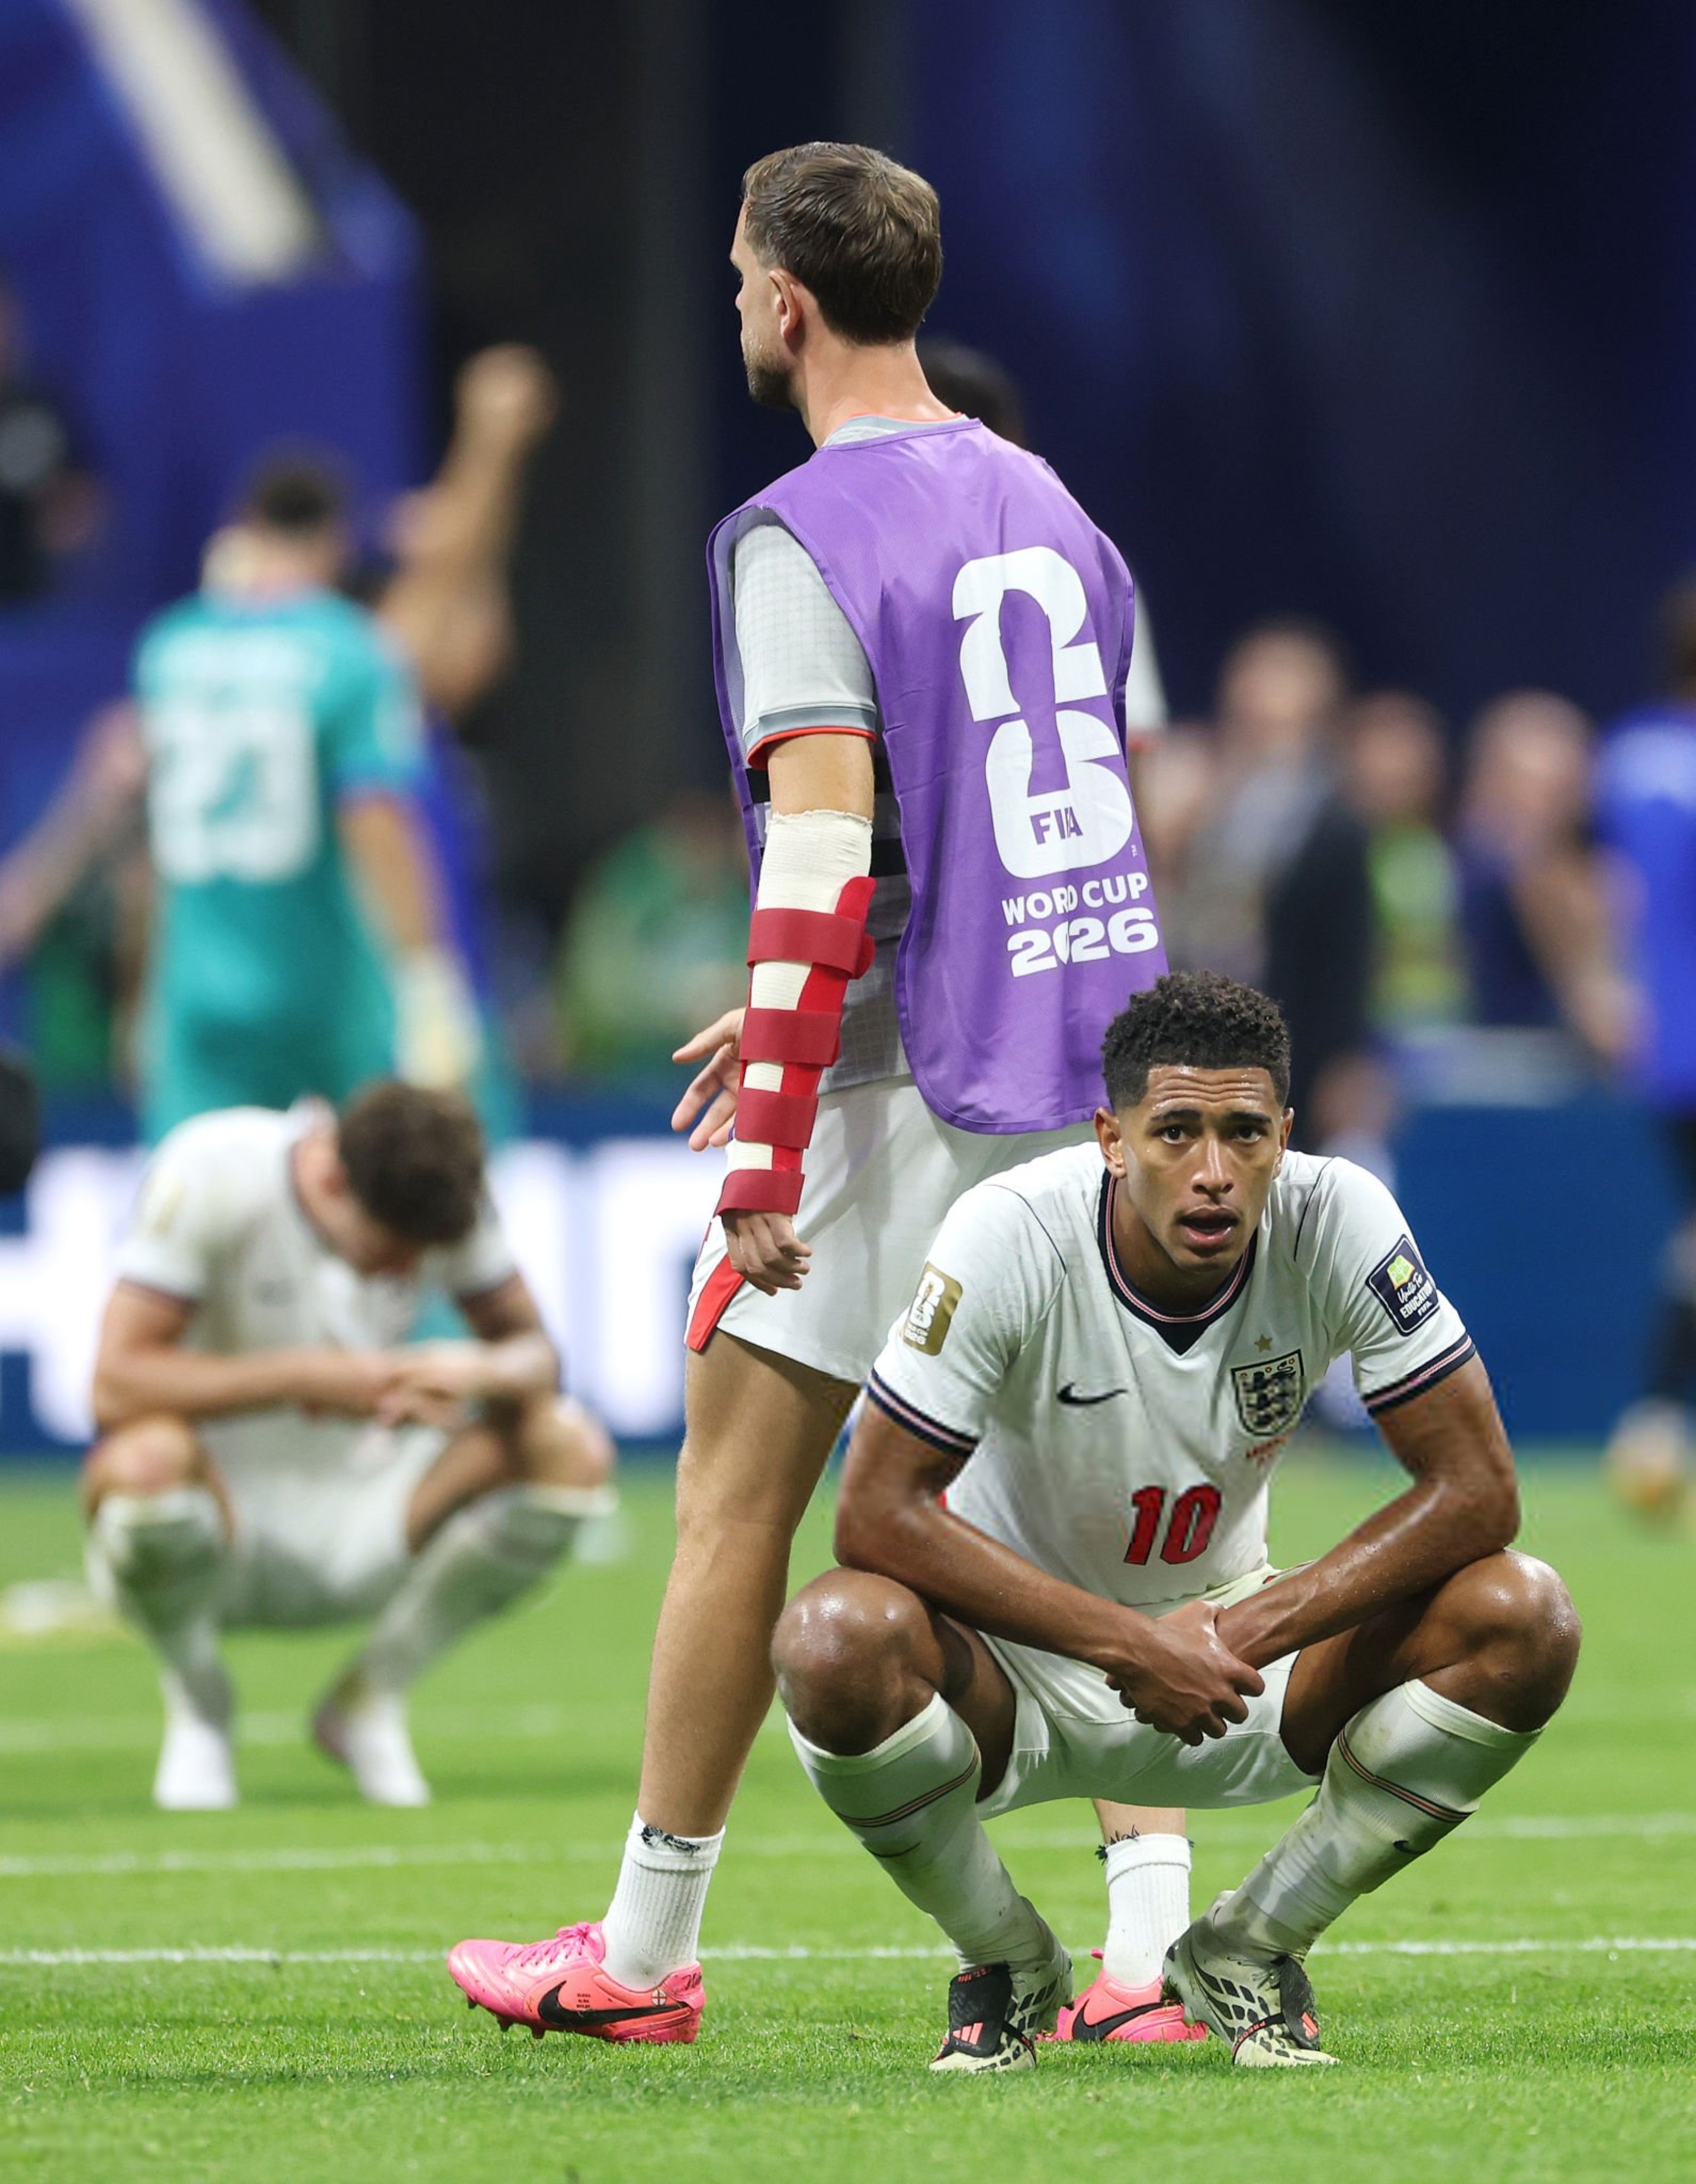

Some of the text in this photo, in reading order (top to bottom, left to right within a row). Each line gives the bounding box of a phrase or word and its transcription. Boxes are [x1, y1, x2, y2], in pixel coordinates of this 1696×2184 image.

[1001, 872, 1148, 926] WORD CUP
[1123, 1484, 1221, 1565] 10
